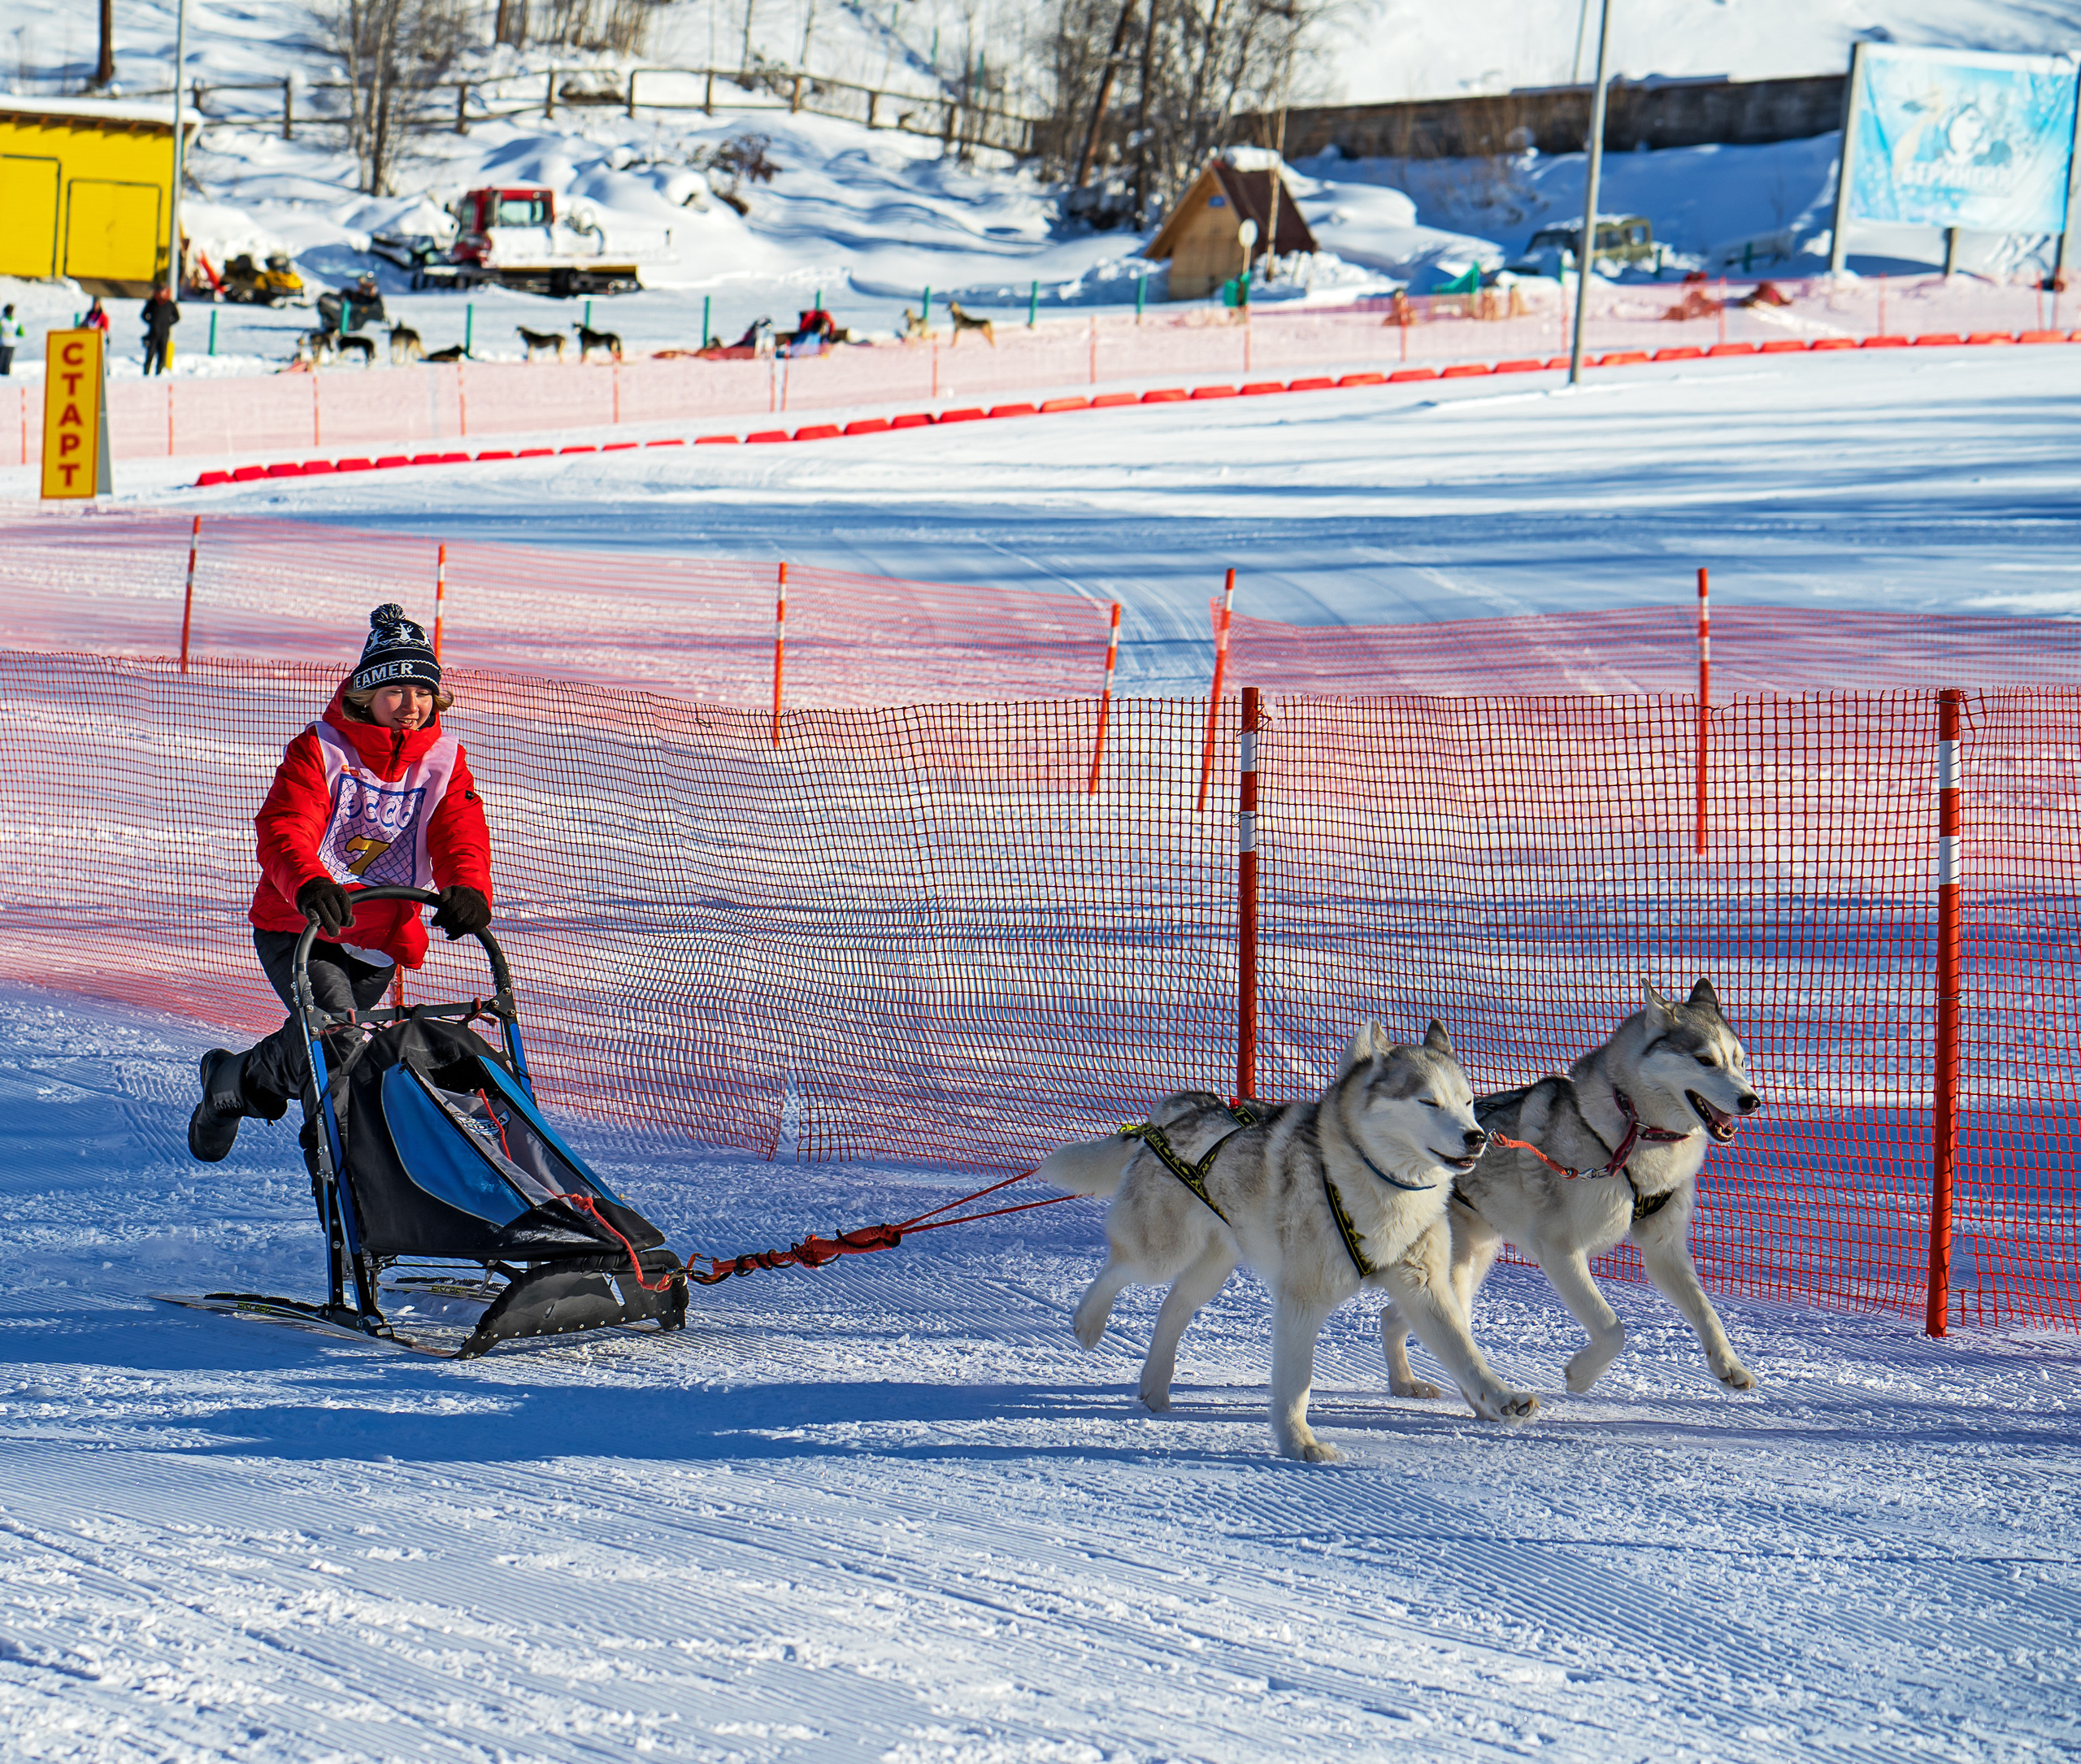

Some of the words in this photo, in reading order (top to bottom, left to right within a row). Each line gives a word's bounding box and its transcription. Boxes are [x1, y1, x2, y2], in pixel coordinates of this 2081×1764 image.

[58, 341, 84, 488] СТАРТ
[354, 663, 414, 689] EAMER
[345, 833, 391, 876] 7
[237, 1301, 272, 1315] FISCHER
